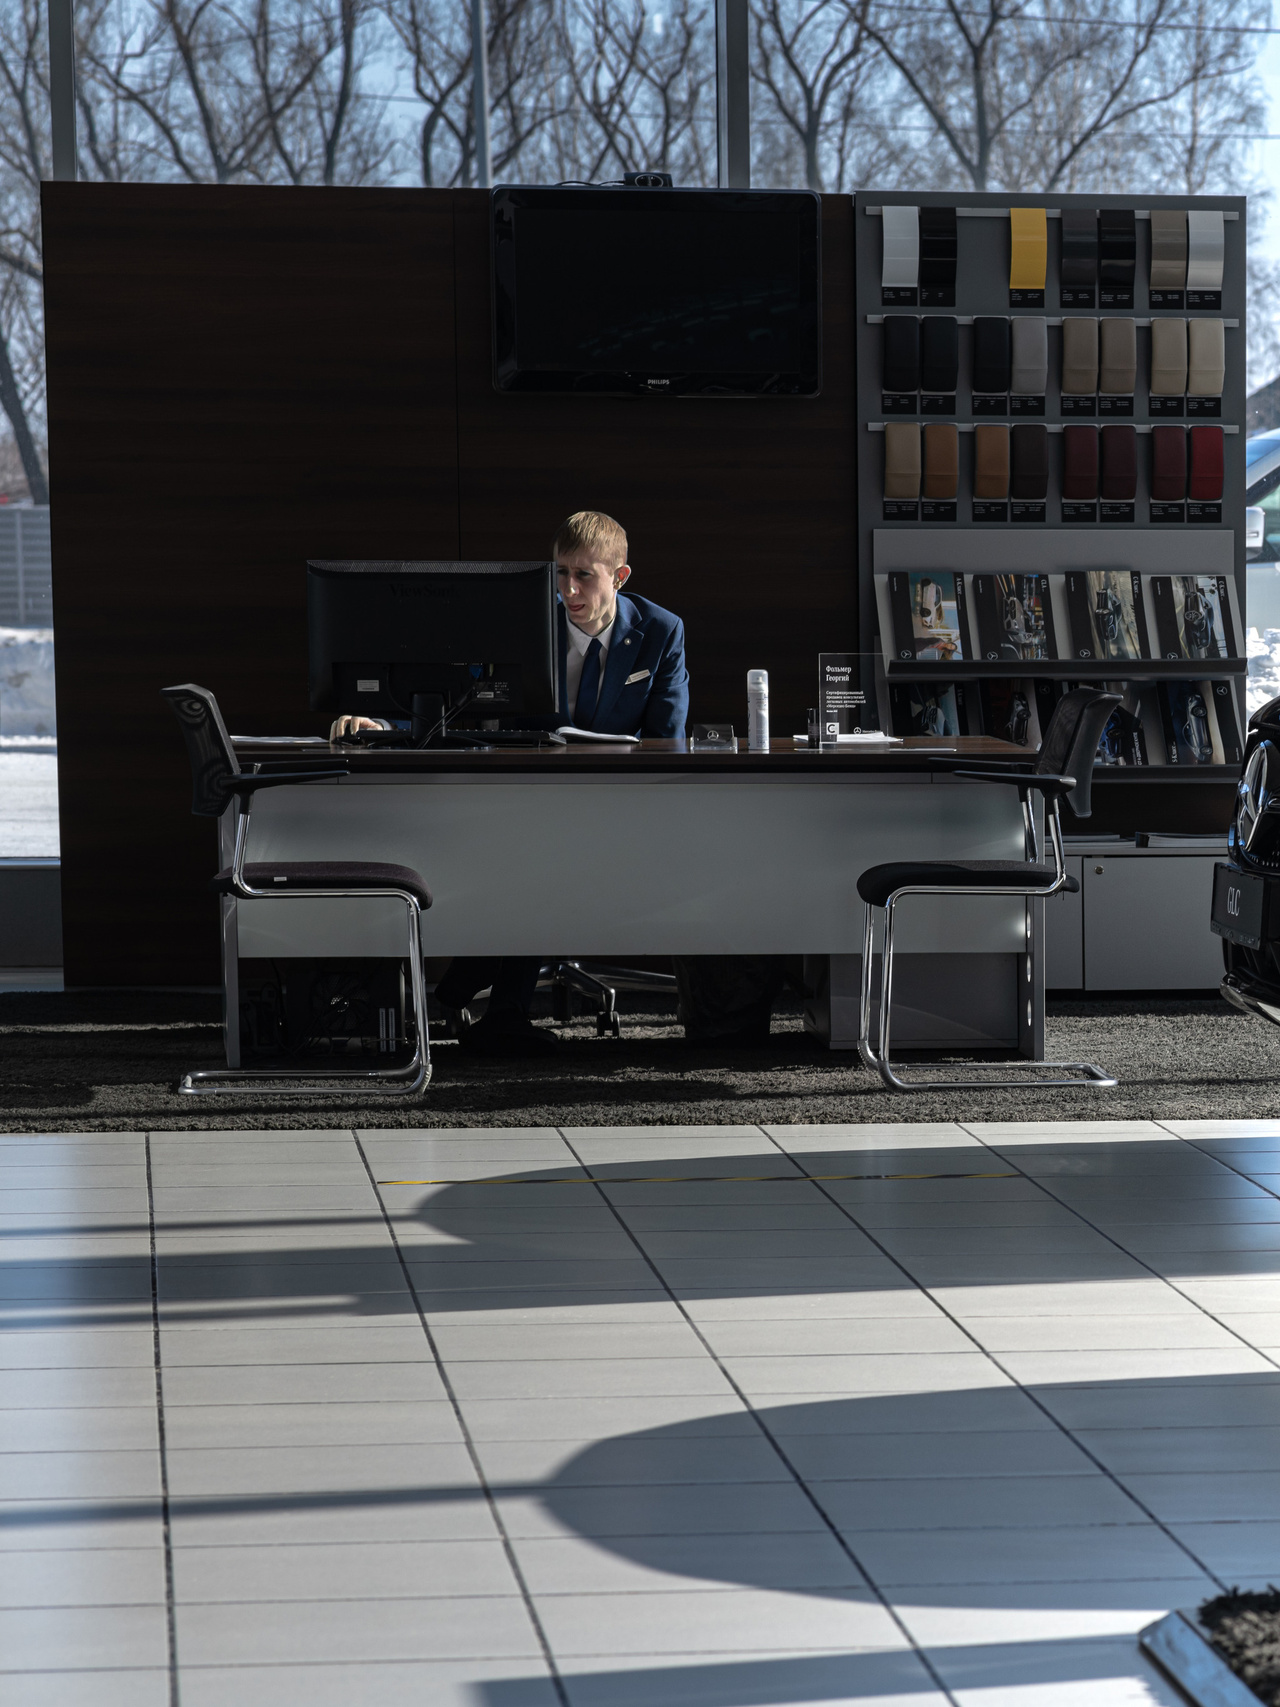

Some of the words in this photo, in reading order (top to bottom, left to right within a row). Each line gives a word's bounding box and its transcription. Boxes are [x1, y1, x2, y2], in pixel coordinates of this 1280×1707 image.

[826, 665, 851, 673] Фольмер
[826, 674, 849, 682] Георгий
[1227, 886, 1240, 916] GLC
